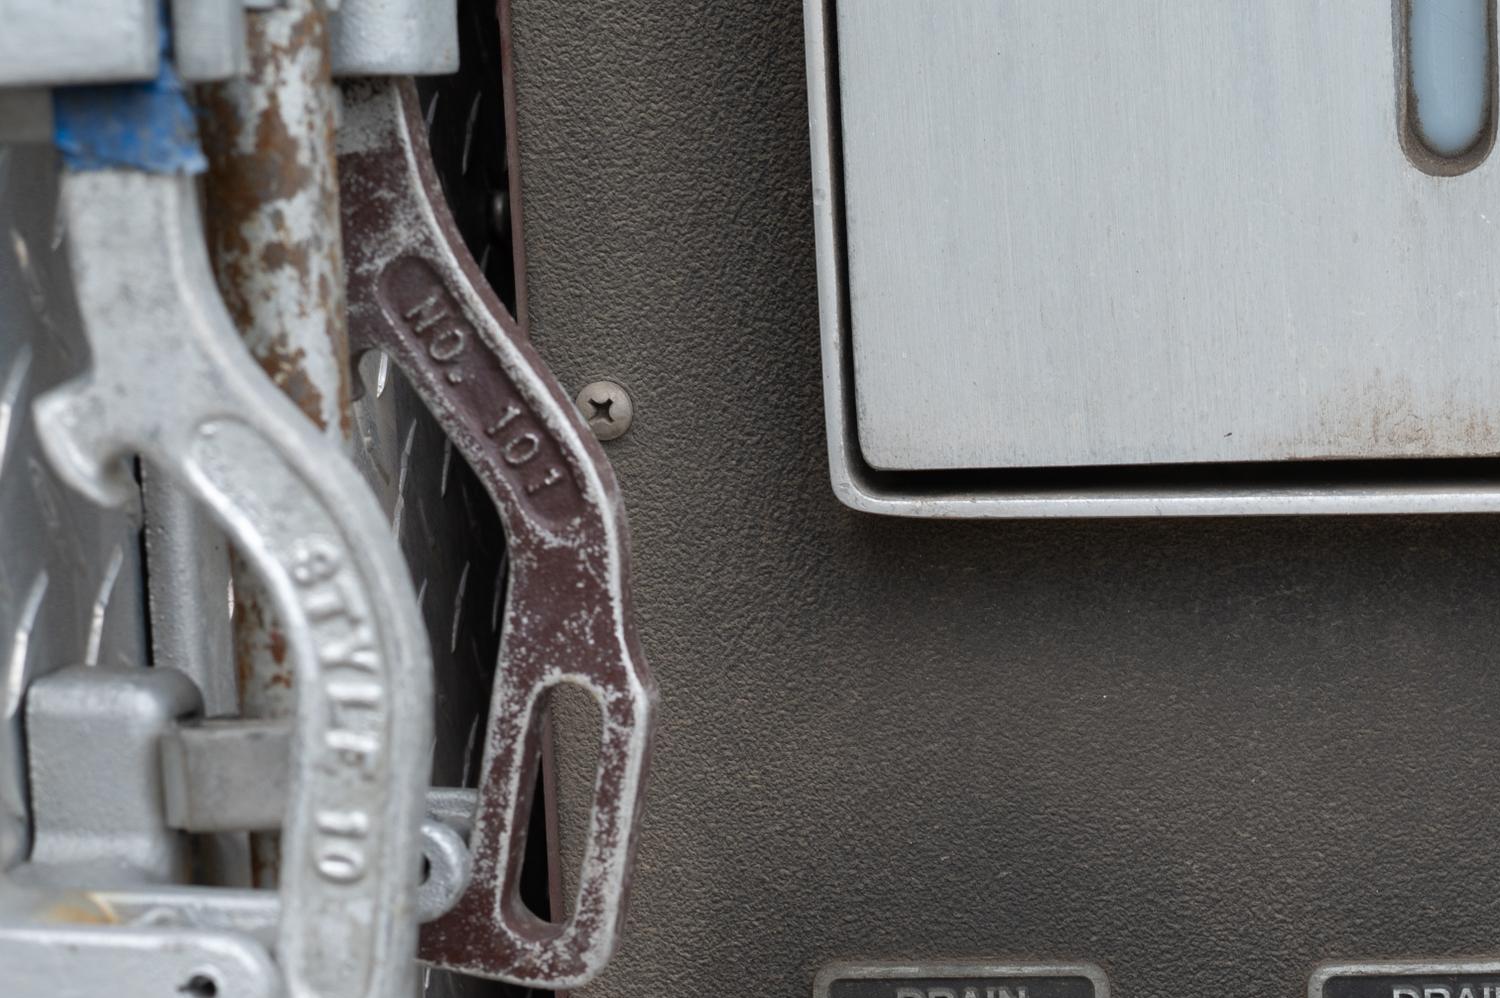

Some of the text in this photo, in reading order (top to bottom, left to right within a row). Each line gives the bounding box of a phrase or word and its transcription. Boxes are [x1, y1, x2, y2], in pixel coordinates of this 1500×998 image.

[404, 295, 562, 494] NO. 101
[315, 808, 369, 882] 10
